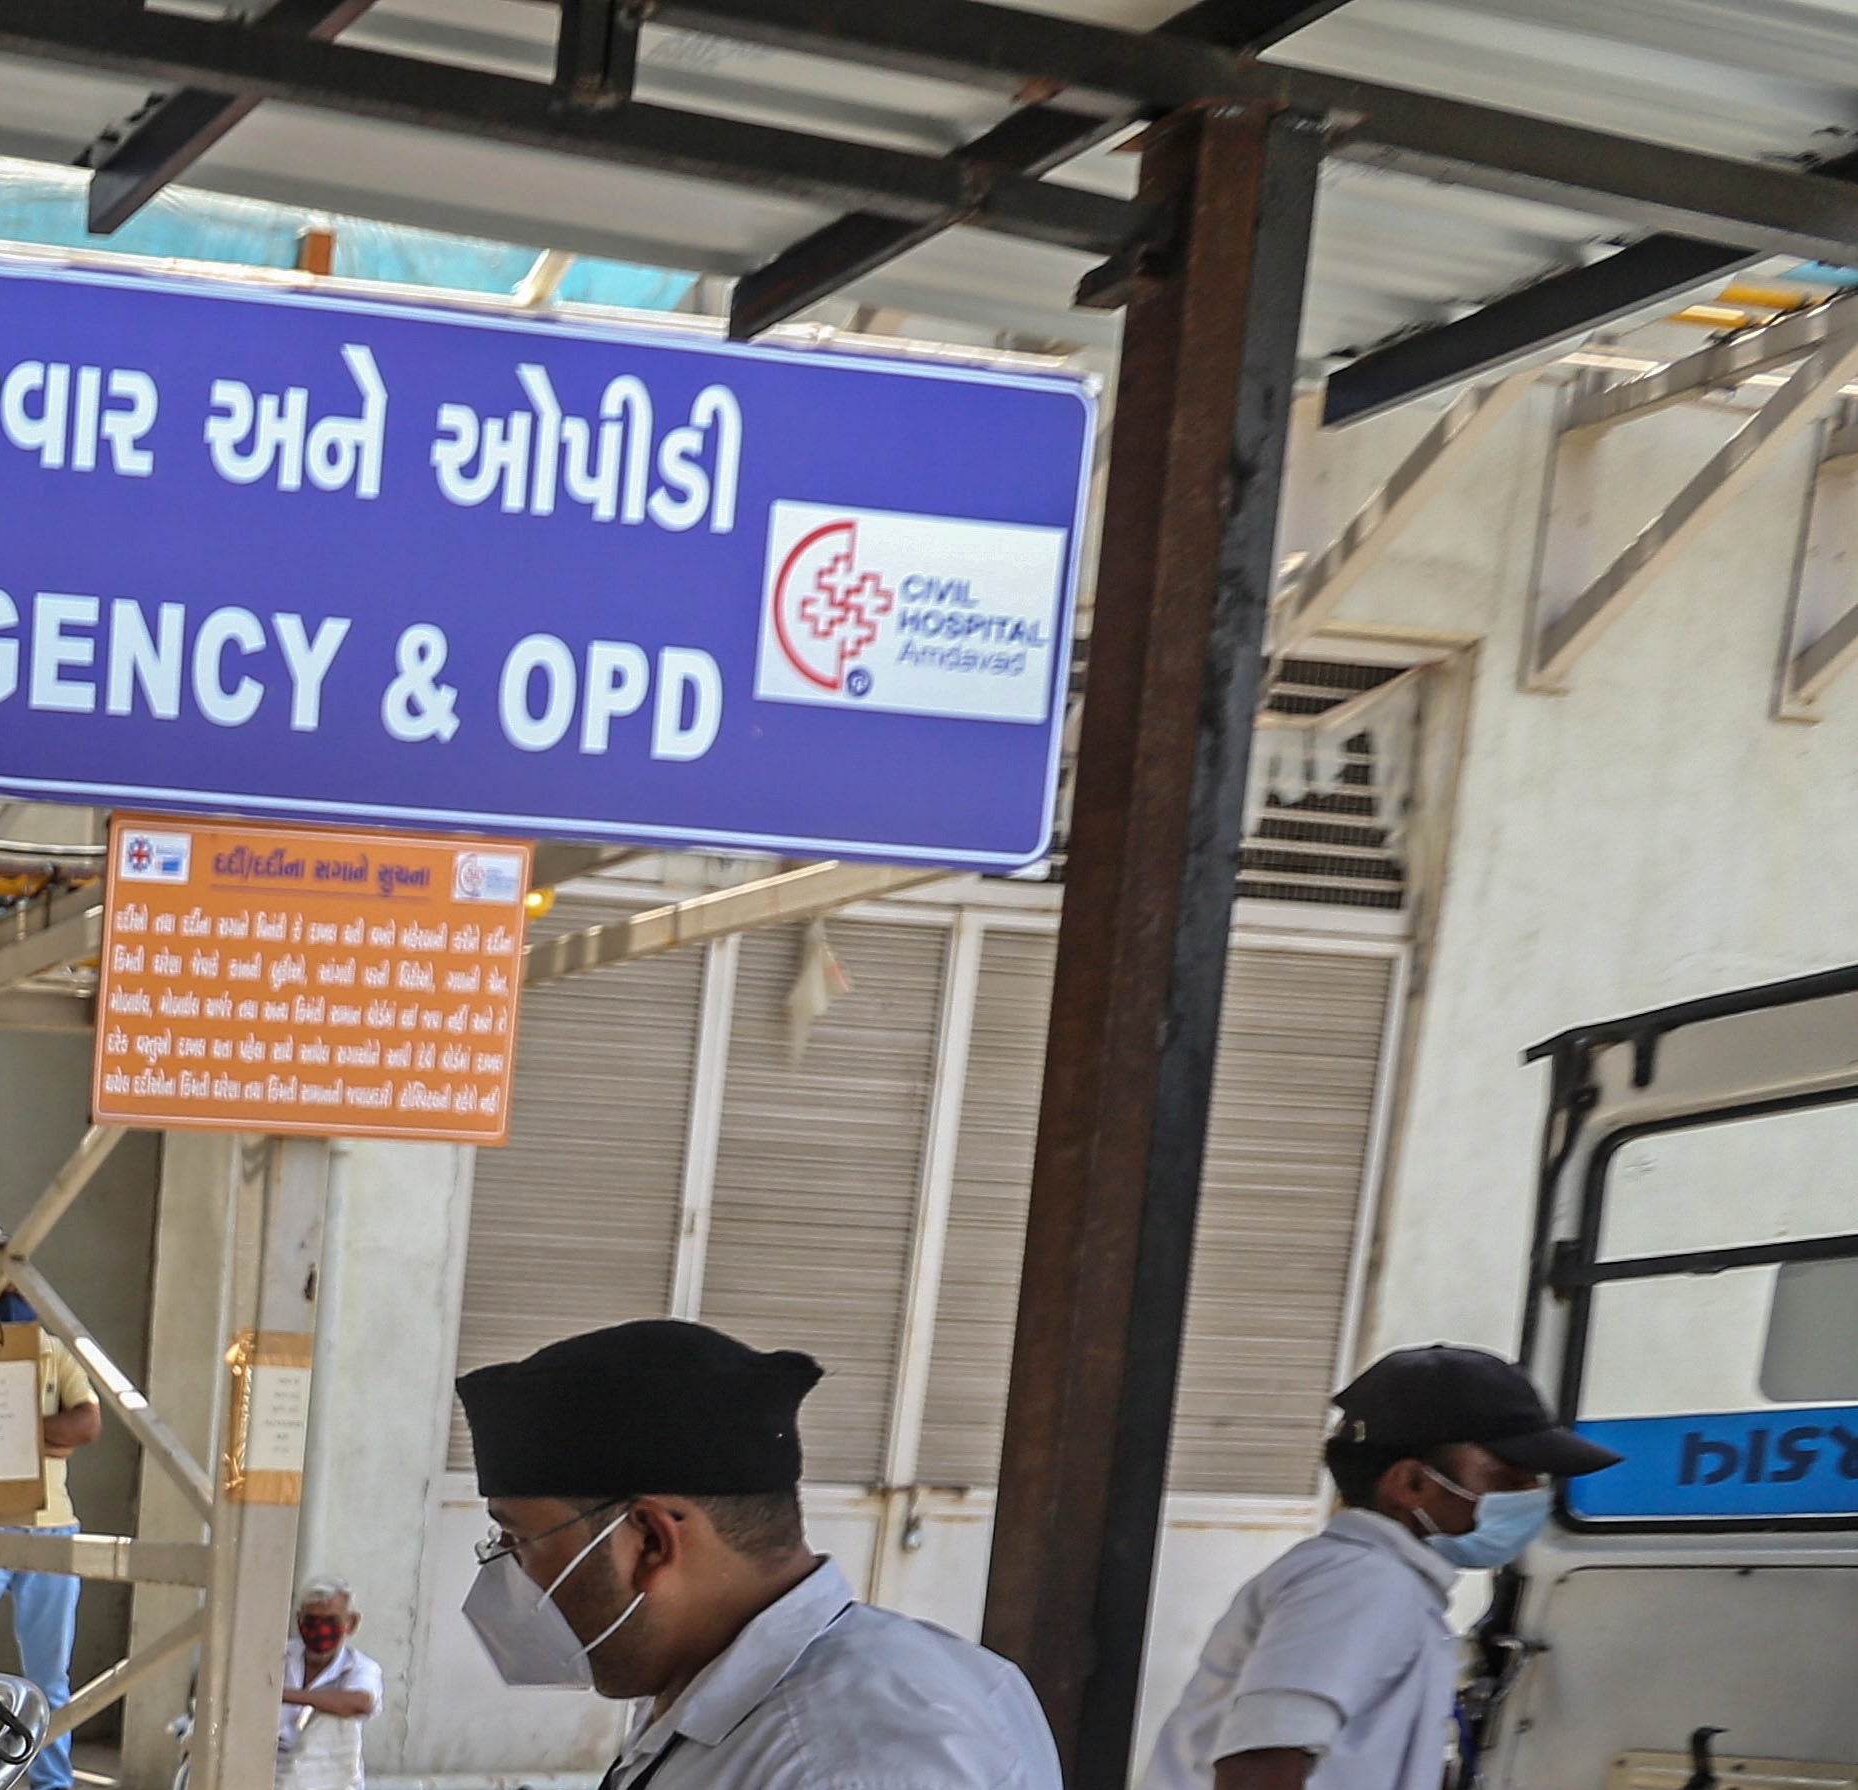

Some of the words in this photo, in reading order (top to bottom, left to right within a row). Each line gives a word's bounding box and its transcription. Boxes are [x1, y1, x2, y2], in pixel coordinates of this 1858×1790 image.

[203, 344, 388, 500] અને
[430, 363, 743, 534] ઓપીડી
[897, 608, 1047, 647] HOSPITAL
[902, 574, 979, 607] CIVIL
[382, 623, 460, 743] &
[499, 633, 724, 762] OPD
